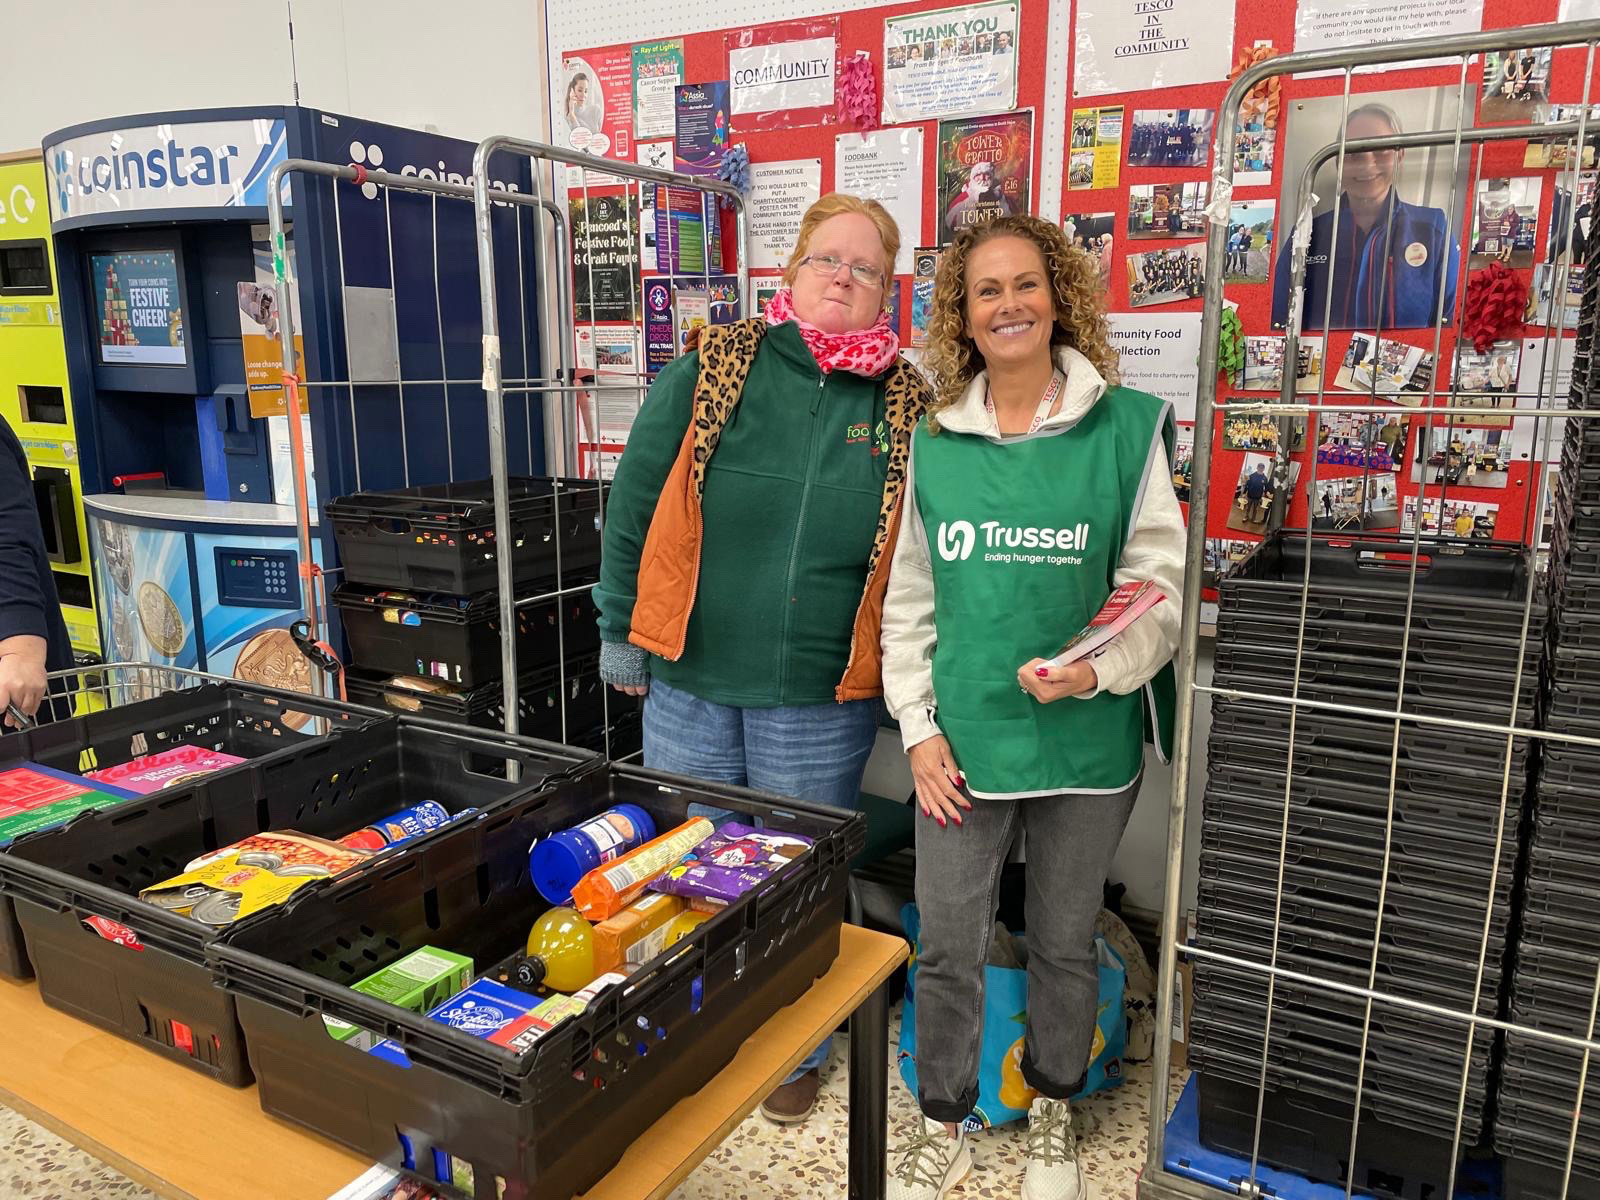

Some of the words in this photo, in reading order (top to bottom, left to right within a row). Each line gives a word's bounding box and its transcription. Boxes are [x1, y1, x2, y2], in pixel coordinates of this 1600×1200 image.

[1135, 0, 1174, 13] TESCO
[1322, 11, 1339, 19] there
[1353, 8, 1366, 18] any
[1366, 6, 1398, 17] upcoming
[1400, 1, 1426, 12] projects
[1147, 14, 1160, 25] IN
[1313, 20, 1349, 31] community
[1363, 15, 1384, 25] would
[1385, 13, 1398, 22] like
[1398, 14, 1409, 23] my
[1410, 11, 1425, 21] help
[1445, 8, 1467, 18] please
[902, 22, 959, 44] THANK
[962, 16, 998, 35] YOU
[1139, 27, 1164, 39] THE
[1324, 31, 1333, 39] do
[1334, 29, 1345, 38] not
[1346, 27, 1373, 37] hesitate
[1382, 25, 1394, 34] get
[1395, 23, 1401, 31] in
[1403, 21, 1422, 31] touch
[1423, 20, 1439, 29] with
[640, 47, 652, 55] Ray
[659, 43, 675, 52] Light
[1114, 38, 1190, 56] COMMUNITY
[734, 57, 830, 86] COMMUNITY
[657, 77, 677, 86] Support
[651, 85, 667, 93] Group
[966, 134, 1003, 151] TOWER
[844, 152, 878, 161] FOODBANK
[965, 148, 1003, 164] GROTTO
[78, 138, 239, 196] coinstar
[756, 170, 784, 178] CUSTOMER
[784, 168, 804, 176] NOTICE
[1004, 180, 1018, 191] £16
[753, 196, 805, 205] CHARITY/COMMUNITY
[753, 211, 782, 219] COMMUNITY
[772, 221, 786, 229] HAND
[574, 236, 610, 250] Festive
[610, 234, 635, 248] Food
[574, 253, 581, 266] &
[583, 252, 609, 266] Craft
[769, 280, 781, 288] 30T
[129, 287, 170, 307] FESTIVE
[132, 308, 168, 327] CHEER!
[649, 333, 670, 342] DROS
[1154, 328, 1182, 339] Food
[1115, 345, 1161, 356] ollection
[261, 360, 282, 369] change
[1160, 371, 1179, 379] charity
[1043, 377, 1059, 402] TESCO
[980, 520, 1089, 551] Trussell
[984, 553, 1011, 562] Ending
[1013, 552, 1045, 564] hunger
[1046, 555, 1082, 565] together
[129, 763, 185, 782] Sultana
[147, 767, 190, 782] Bran
[440, 1006, 516, 1031] Stockwell
[512, 1026, 547, 1049] TEA
